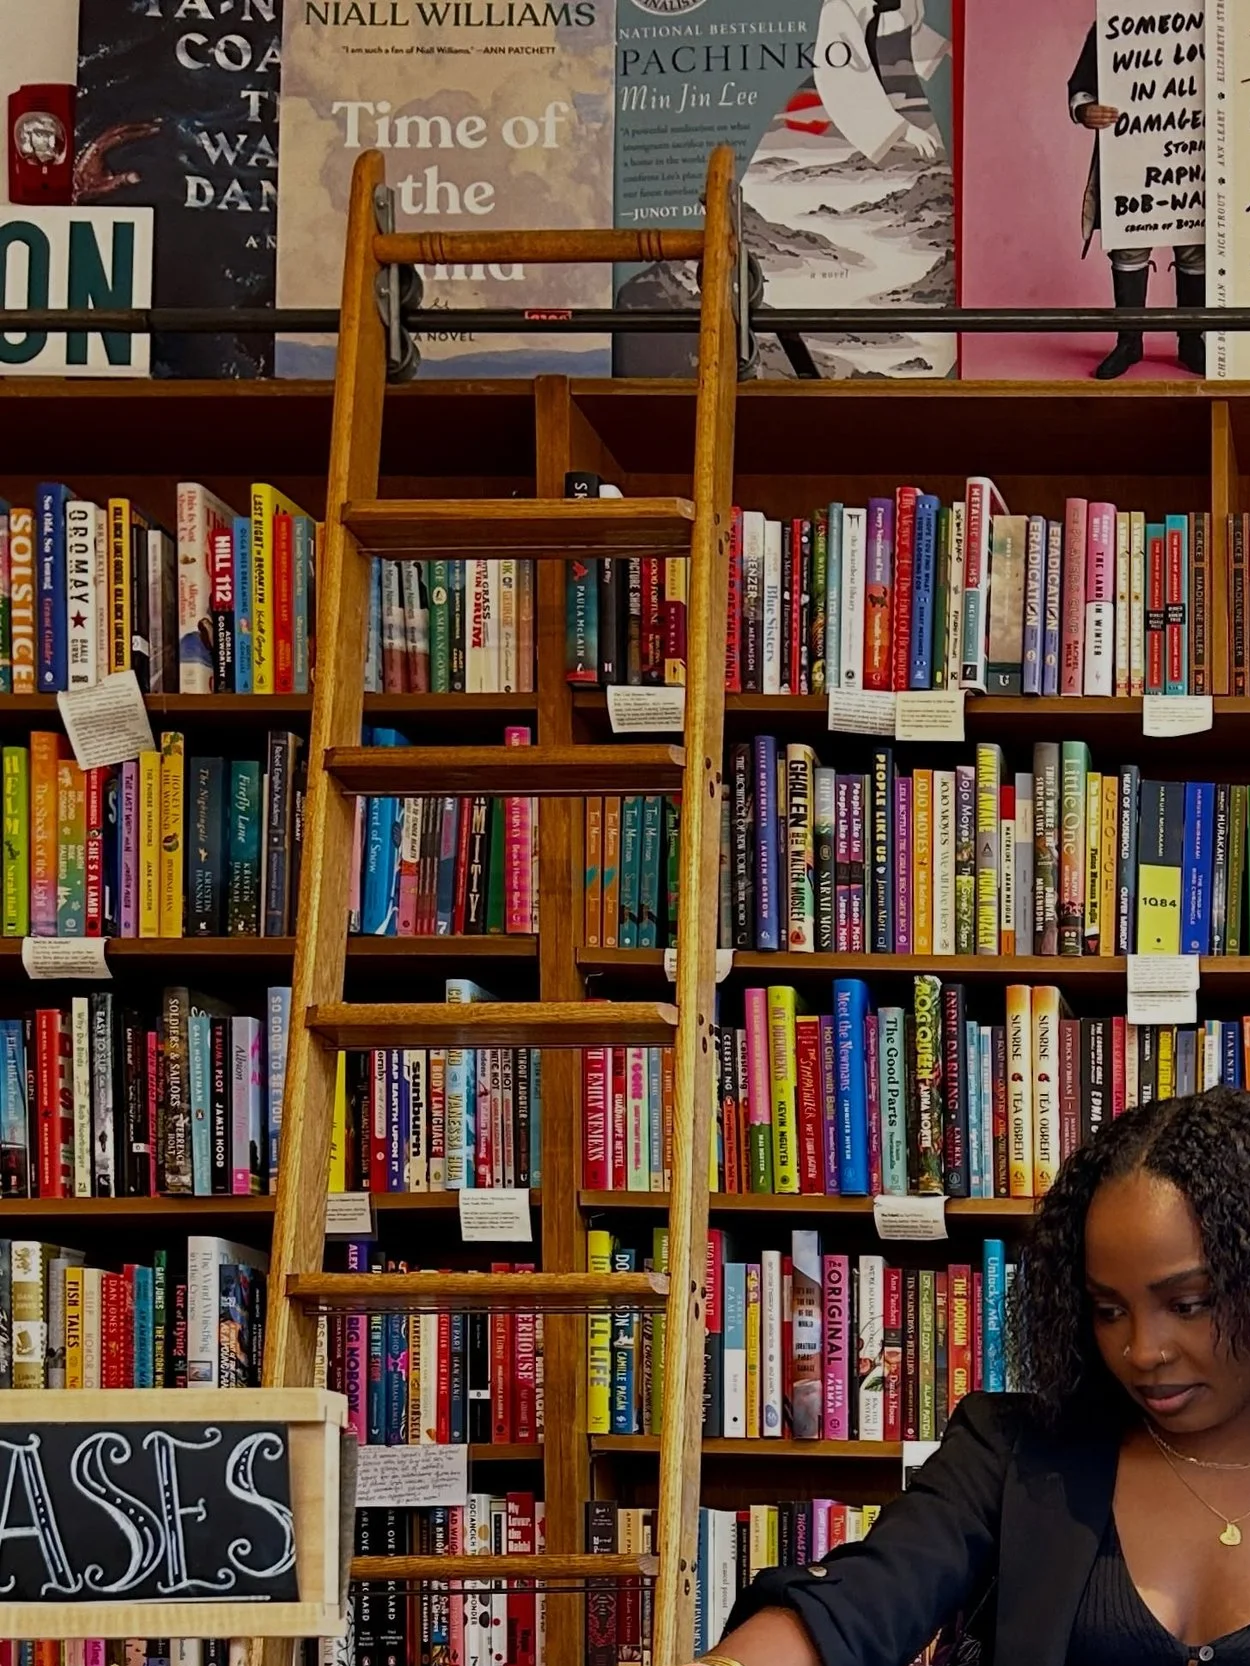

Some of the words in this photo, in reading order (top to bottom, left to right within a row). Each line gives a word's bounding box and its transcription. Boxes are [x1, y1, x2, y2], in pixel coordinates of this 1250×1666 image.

[305, 1, 409, 27] NIALL
[415, 1, 596, 28] WILLIAMS
[619, 25, 702, 40] NATIONAL
[709, 20, 808, 36] BESTSELLER
[508, 46, 556, 55] PATCHETT
[619, 41, 852, 77] PACHINKO
[1113, 48, 1163, 73] WILL
[619, 84, 671, 112] Min
[676, 83, 711, 114] Jin
[718, 81, 758, 107] Lee
[1130, 79, 1157, 102] IN
[1162, 75, 1197, 99] ALL
[332, 100, 487, 149] Time
[502, 100, 570, 149] of
[397, 164, 496, 216] the
[1217, 192, 1226, 228] TROUT
[1217, 231, 1226, 258] NICK
[822, 268, 850, 279] novel
[413, 332, 423, 342] A
[427, 332, 475, 342] NOVEL
[69, 509, 89, 604] OROMAY
[215, 534, 233, 577] HILL
[10, 513, 34, 685] SOLSTICE
[215, 579, 233, 603] 112
[575, 585, 586, 617] PAULA
[238, 773, 251, 811] Firefly
[875, 754, 886, 806] PEOPLE
[237, 814, 250, 844] Lane
[875, 811, 886, 842] LIKE
[875, 846, 887, 864] US
[1142, 896, 1177, 909] 1Q84
[886, 1018, 898, 1044] The
[1011, 1014, 1022, 1061] SUNRISE
[886, 1047, 899, 1084] Good
[411, 1060, 424, 1158] sunburn
[887, 1085, 900, 1127] Parts
[67, 1281, 80, 1306] FISH
[67, 1310, 80, 1348] TALES
[827, 1270, 843, 1366] ORIGINAL
